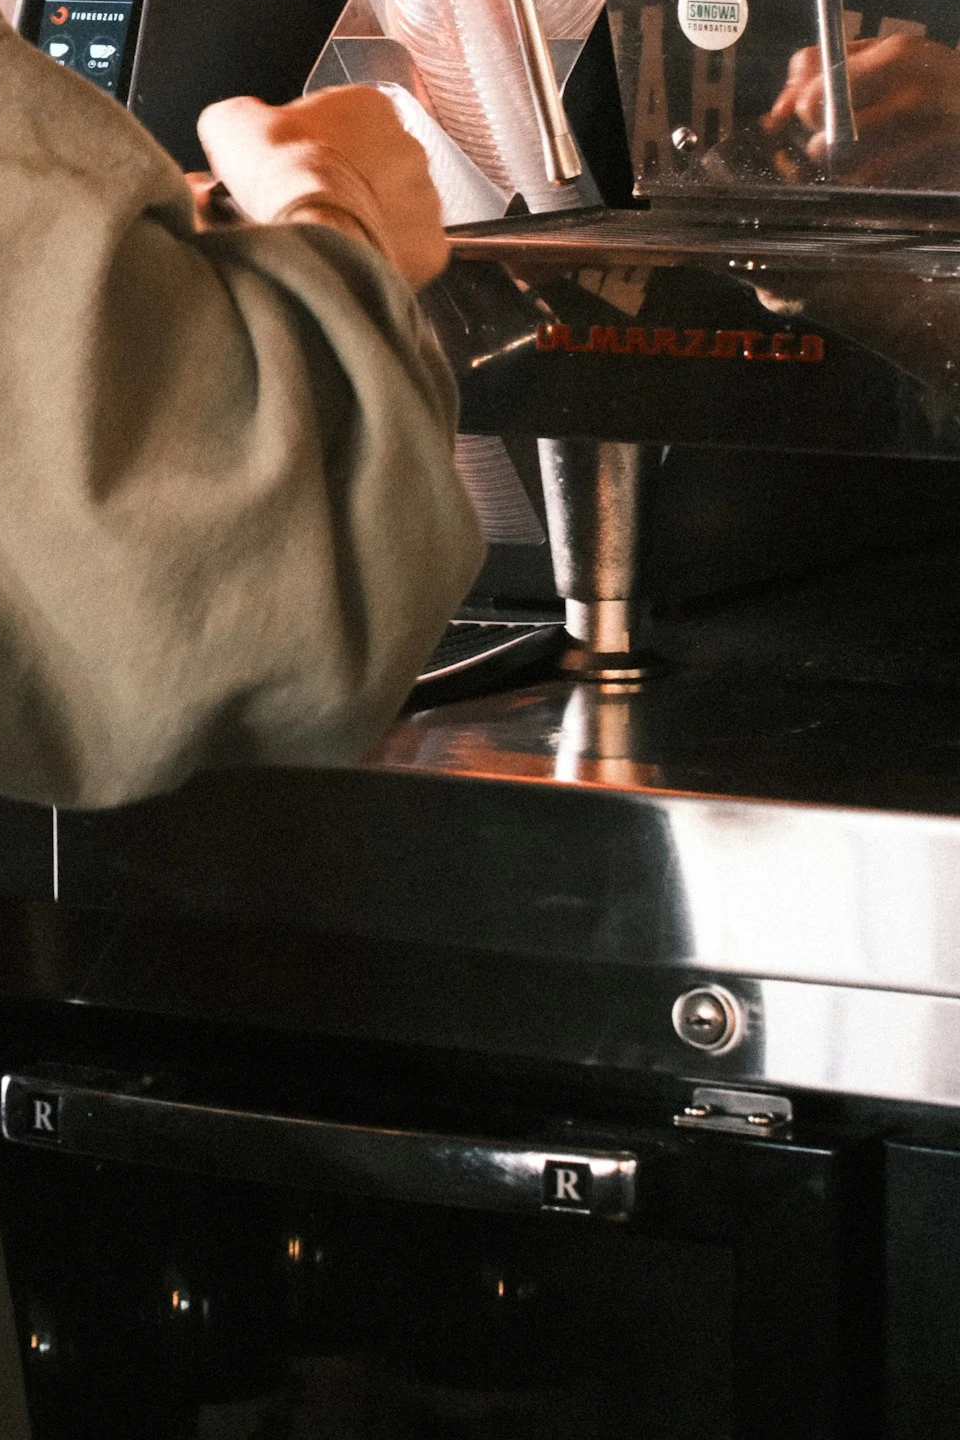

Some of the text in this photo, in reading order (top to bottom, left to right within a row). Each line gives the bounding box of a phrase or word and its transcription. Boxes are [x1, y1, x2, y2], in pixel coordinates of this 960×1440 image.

[689, 4, 736, 20] SONGWA
[688, 23, 738, 33] FOUNDATION
[33, 1099, 54, 1131] R
[554, 1168, 582, 1200] R
